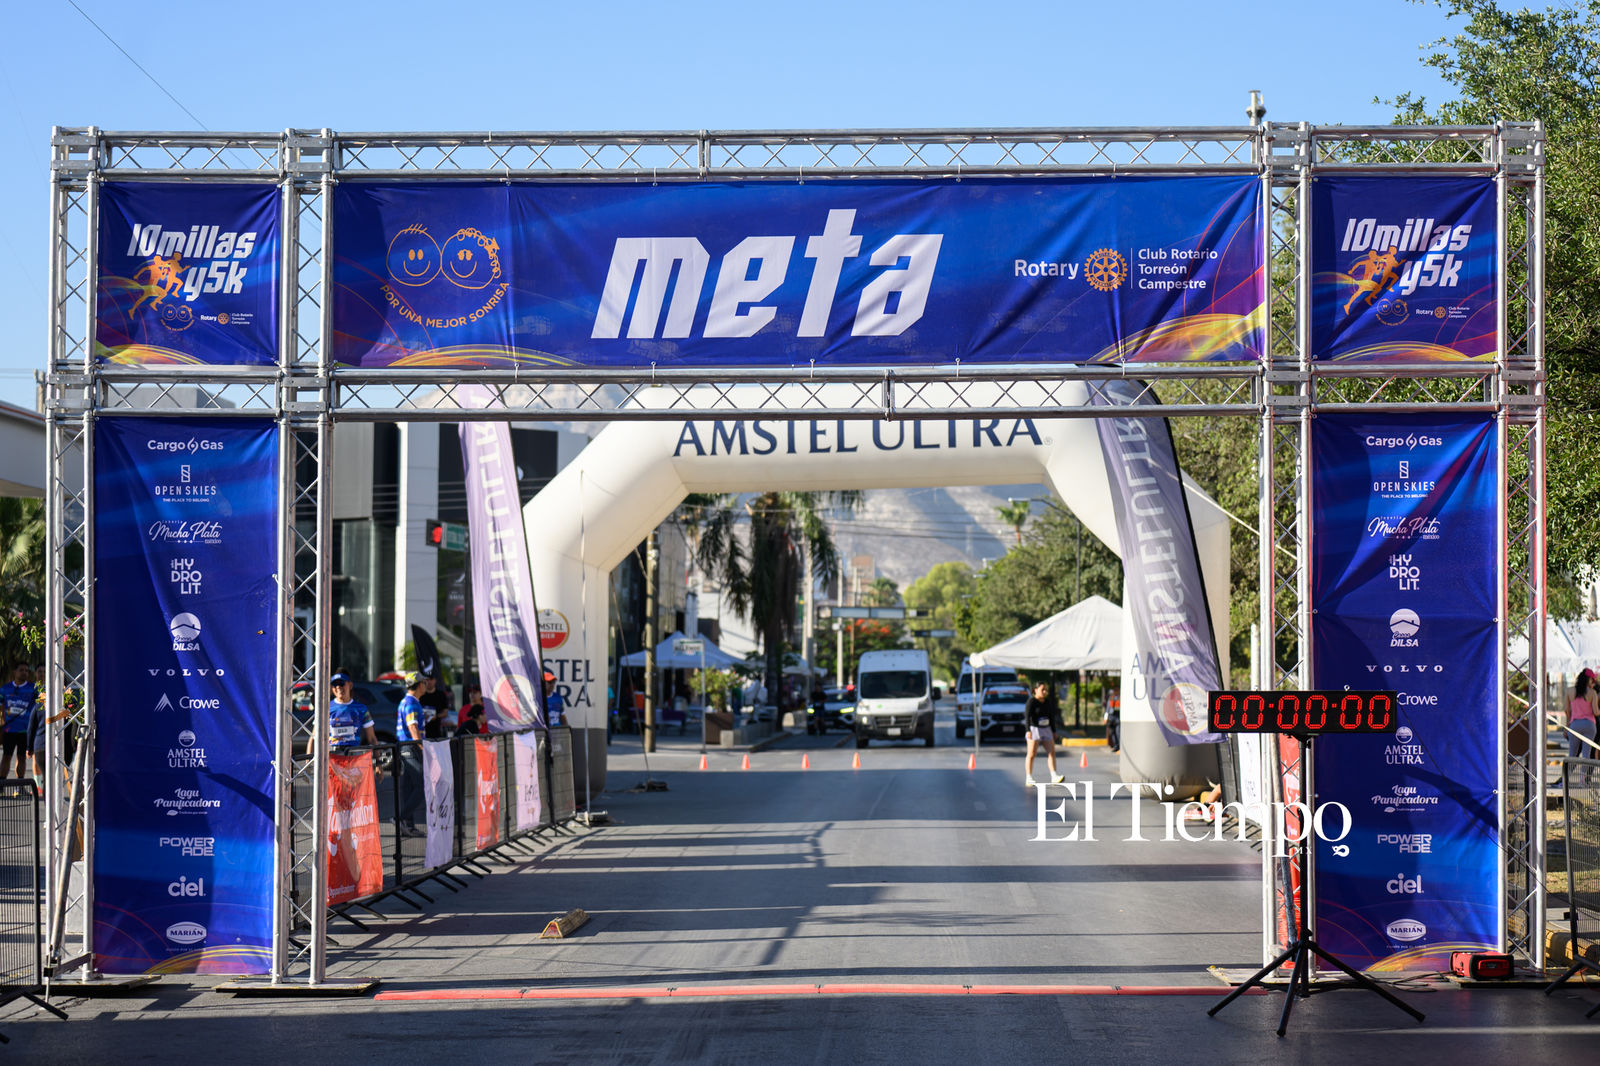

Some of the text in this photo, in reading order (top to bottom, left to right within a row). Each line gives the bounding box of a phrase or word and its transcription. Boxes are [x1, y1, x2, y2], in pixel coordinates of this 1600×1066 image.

[127, 223, 257, 259] 10millas
[1341, 218, 1473, 252] 10millas
[1138, 248, 1218, 260] Club Rotario
[590, 208, 944, 339] meta
[1014, 259, 1079, 280] Rotary
[1138, 263, 1188, 275] Torreón
[1399, 253, 1463, 296] y5k
[183, 260, 248, 302] y5k
[1138, 278, 1207, 291] Campestre
[380, 282, 510, 328] POR UNA MEJOR SONRISA
[1415, 308, 1434, 316] Rotary
[672, 418, 1043, 456] AMSTEL ULTRA
[1366, 435, 1442, 448] Cargo Gas
[147, 439, 224, 452] Cargo Gas
[155, 485, 217, 496] OPEN SKIES
[1373, 481, 1435, 492] OPEN SKIES
[148, 520, 223, 541] Mucha Plata
[1367, 516, 1441, 537] Mucha Plata
[174, 558, 194, 570] HY
[1392, 554, 1412, 566] HY
[171, 570, 202, 582] DRO
[1389, 566, 1420, 578] DRO
[540, 623, 563, 631] MSTEL
[172, 643, 201, 651] DILSA
[1390, 638, 1419, 647] DILSA
[148, 668, 225, 677] VOLVO
[543, 658, 595, 682] STEL
[1366, 665, 1444, 673] VOLVO
[179, 696, 220, 709] Crowe
[1397, 692, 1438, 706] Crowe
[167, 748, 207, 758] AMSTEL
[1384, 745, 1425, 755] AMSTEL
[168, 758, 206, 768] ULTRA
[1386, 755, 1424, 764] ULTRA
[174, 788, 199, 799] Lagu
[1391, 784, 1417, 796] Lagu
[153, 798, 221, 810] Panificadora
[1371, 795, 1439, 807] Panificadora
[159, 837, 215, 847] POWER
[1377, 834, 1433, 844] POWER
[182, 847, 214, 857] ADE
[1399, 844, 1432, 853] ADE
[168, 875, 204, 897] ciel
[1386, 873, 1422, 894] ciel
[170, 928, 203, 936] MARIÁN
[1390, 925, 1423, 933] MARIÁN
